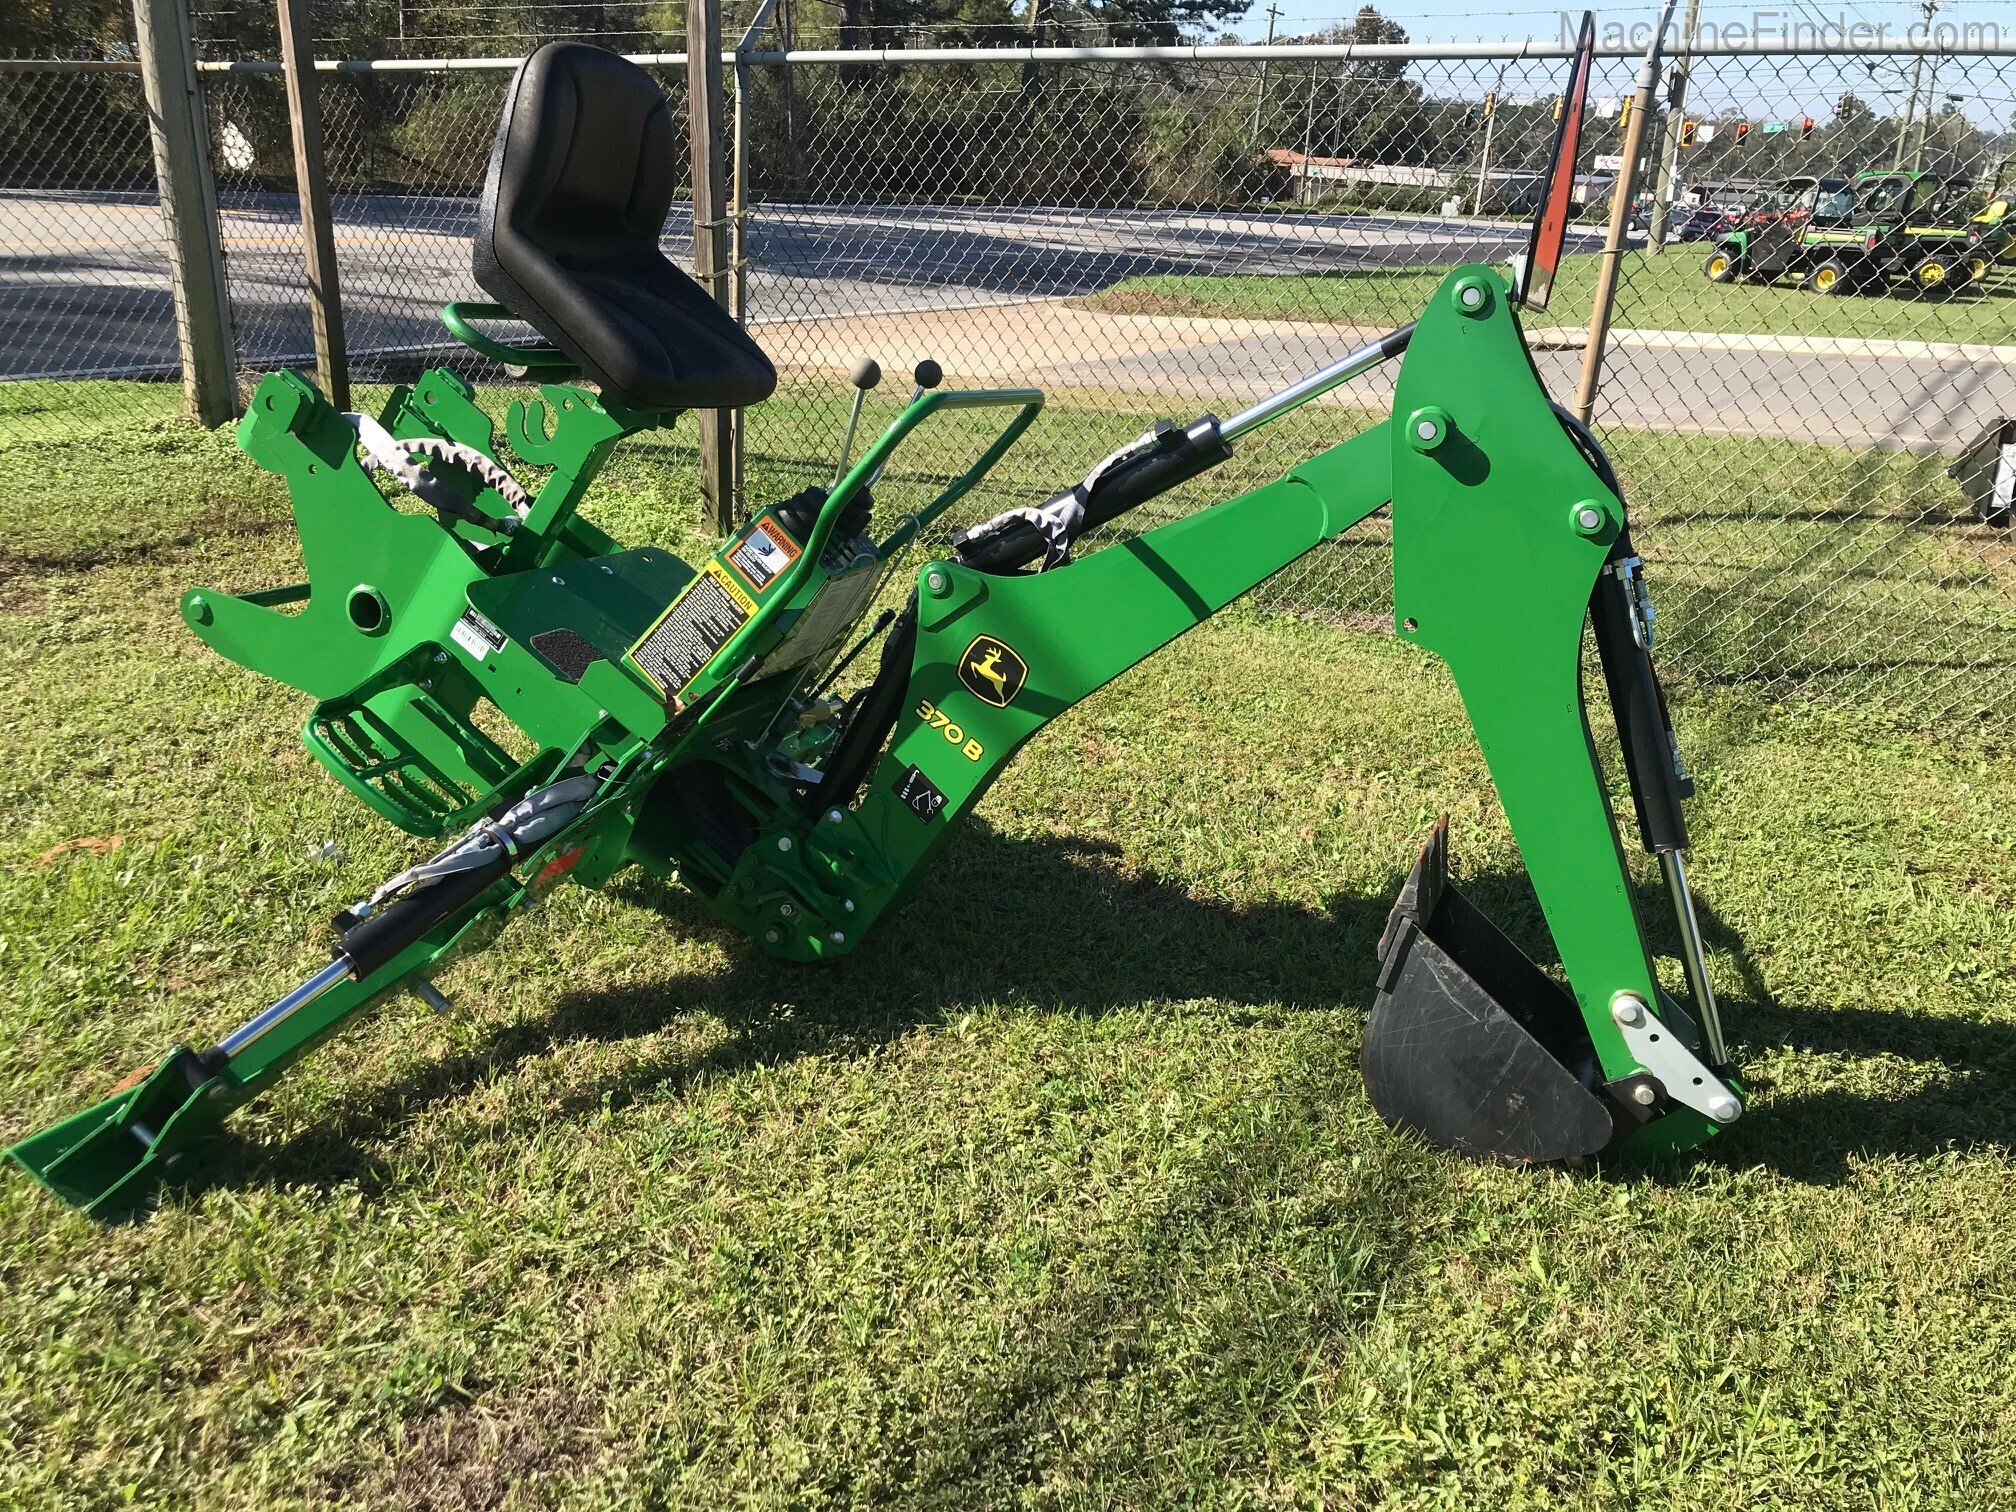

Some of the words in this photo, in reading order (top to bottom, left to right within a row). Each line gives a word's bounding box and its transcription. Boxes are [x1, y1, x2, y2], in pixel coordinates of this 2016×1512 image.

[767, 525, 798, 558] WARNING
[720, 575, 752, 611] CAUTION
[915, 699, 965, 745] 370
[961, 737, 984, 762] B
